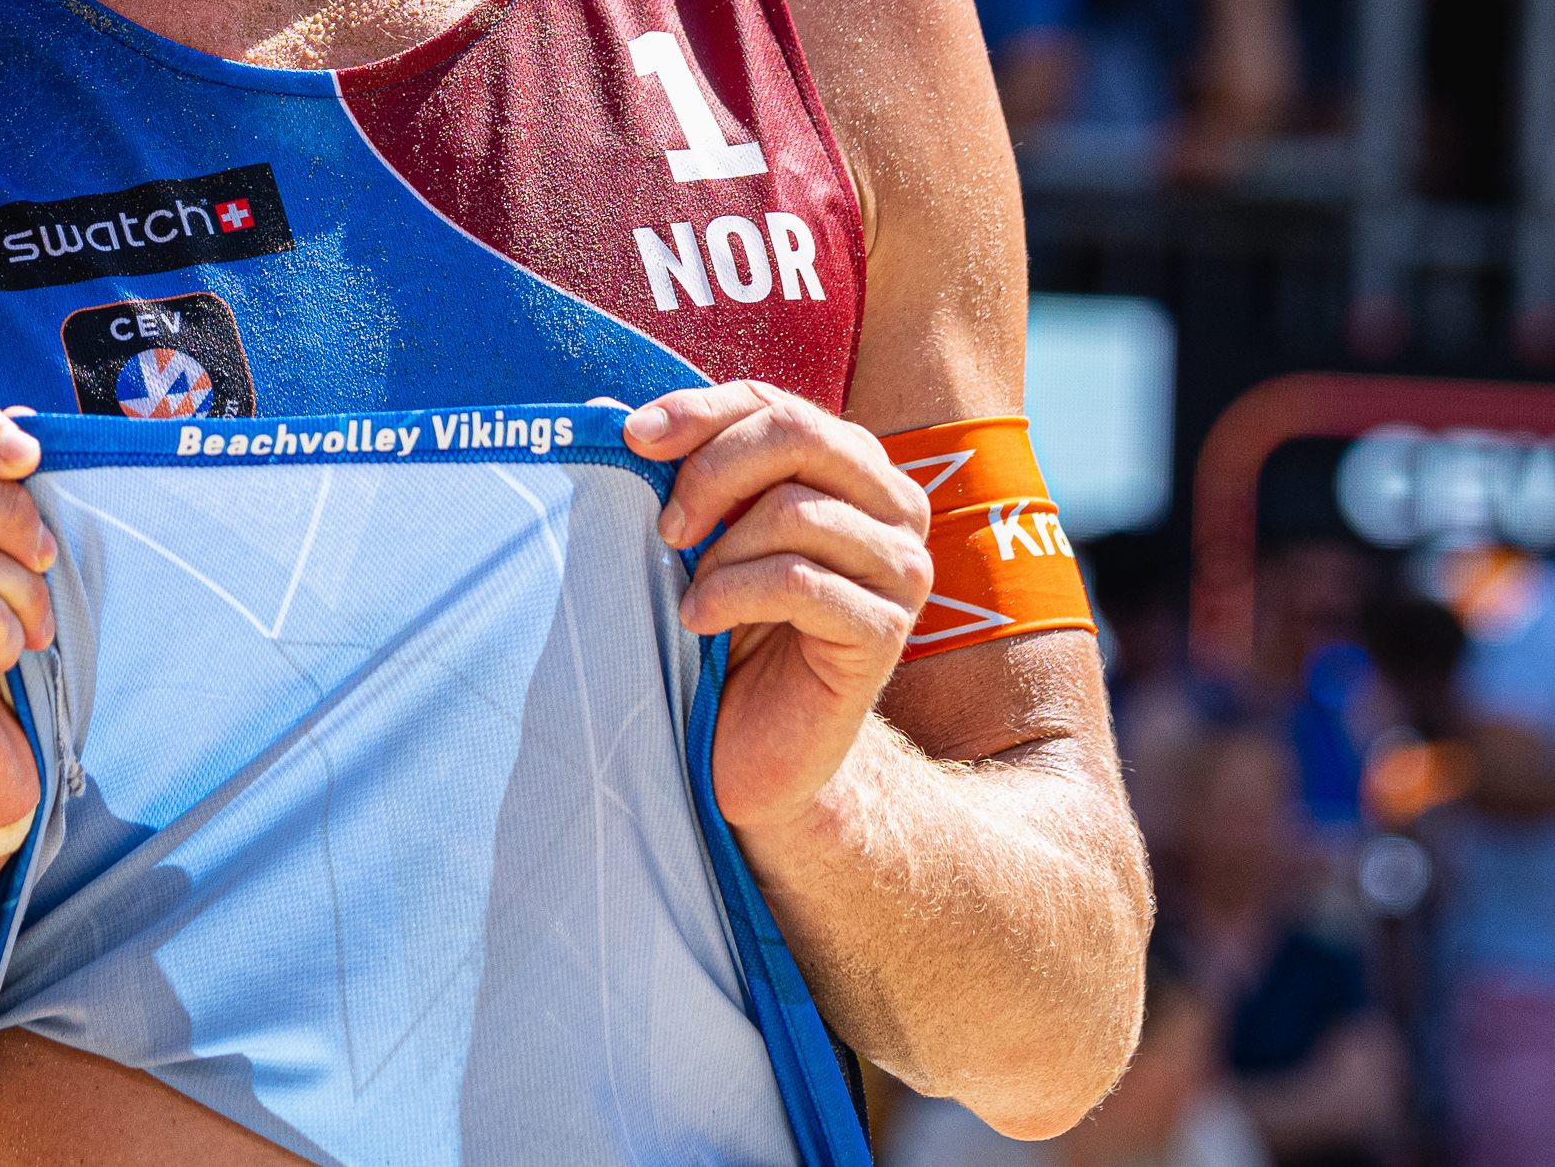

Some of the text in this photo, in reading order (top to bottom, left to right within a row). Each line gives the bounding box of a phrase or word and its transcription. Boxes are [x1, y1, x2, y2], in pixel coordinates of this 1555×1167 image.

[628, 31, 769, 182] 1
[3, 198, 216, 263] swatch
[632, 211, 827, 312] NOR
[110, 311, 182, 341] CEV
[177, 410, 574, 457] Beachvolley Vikings
